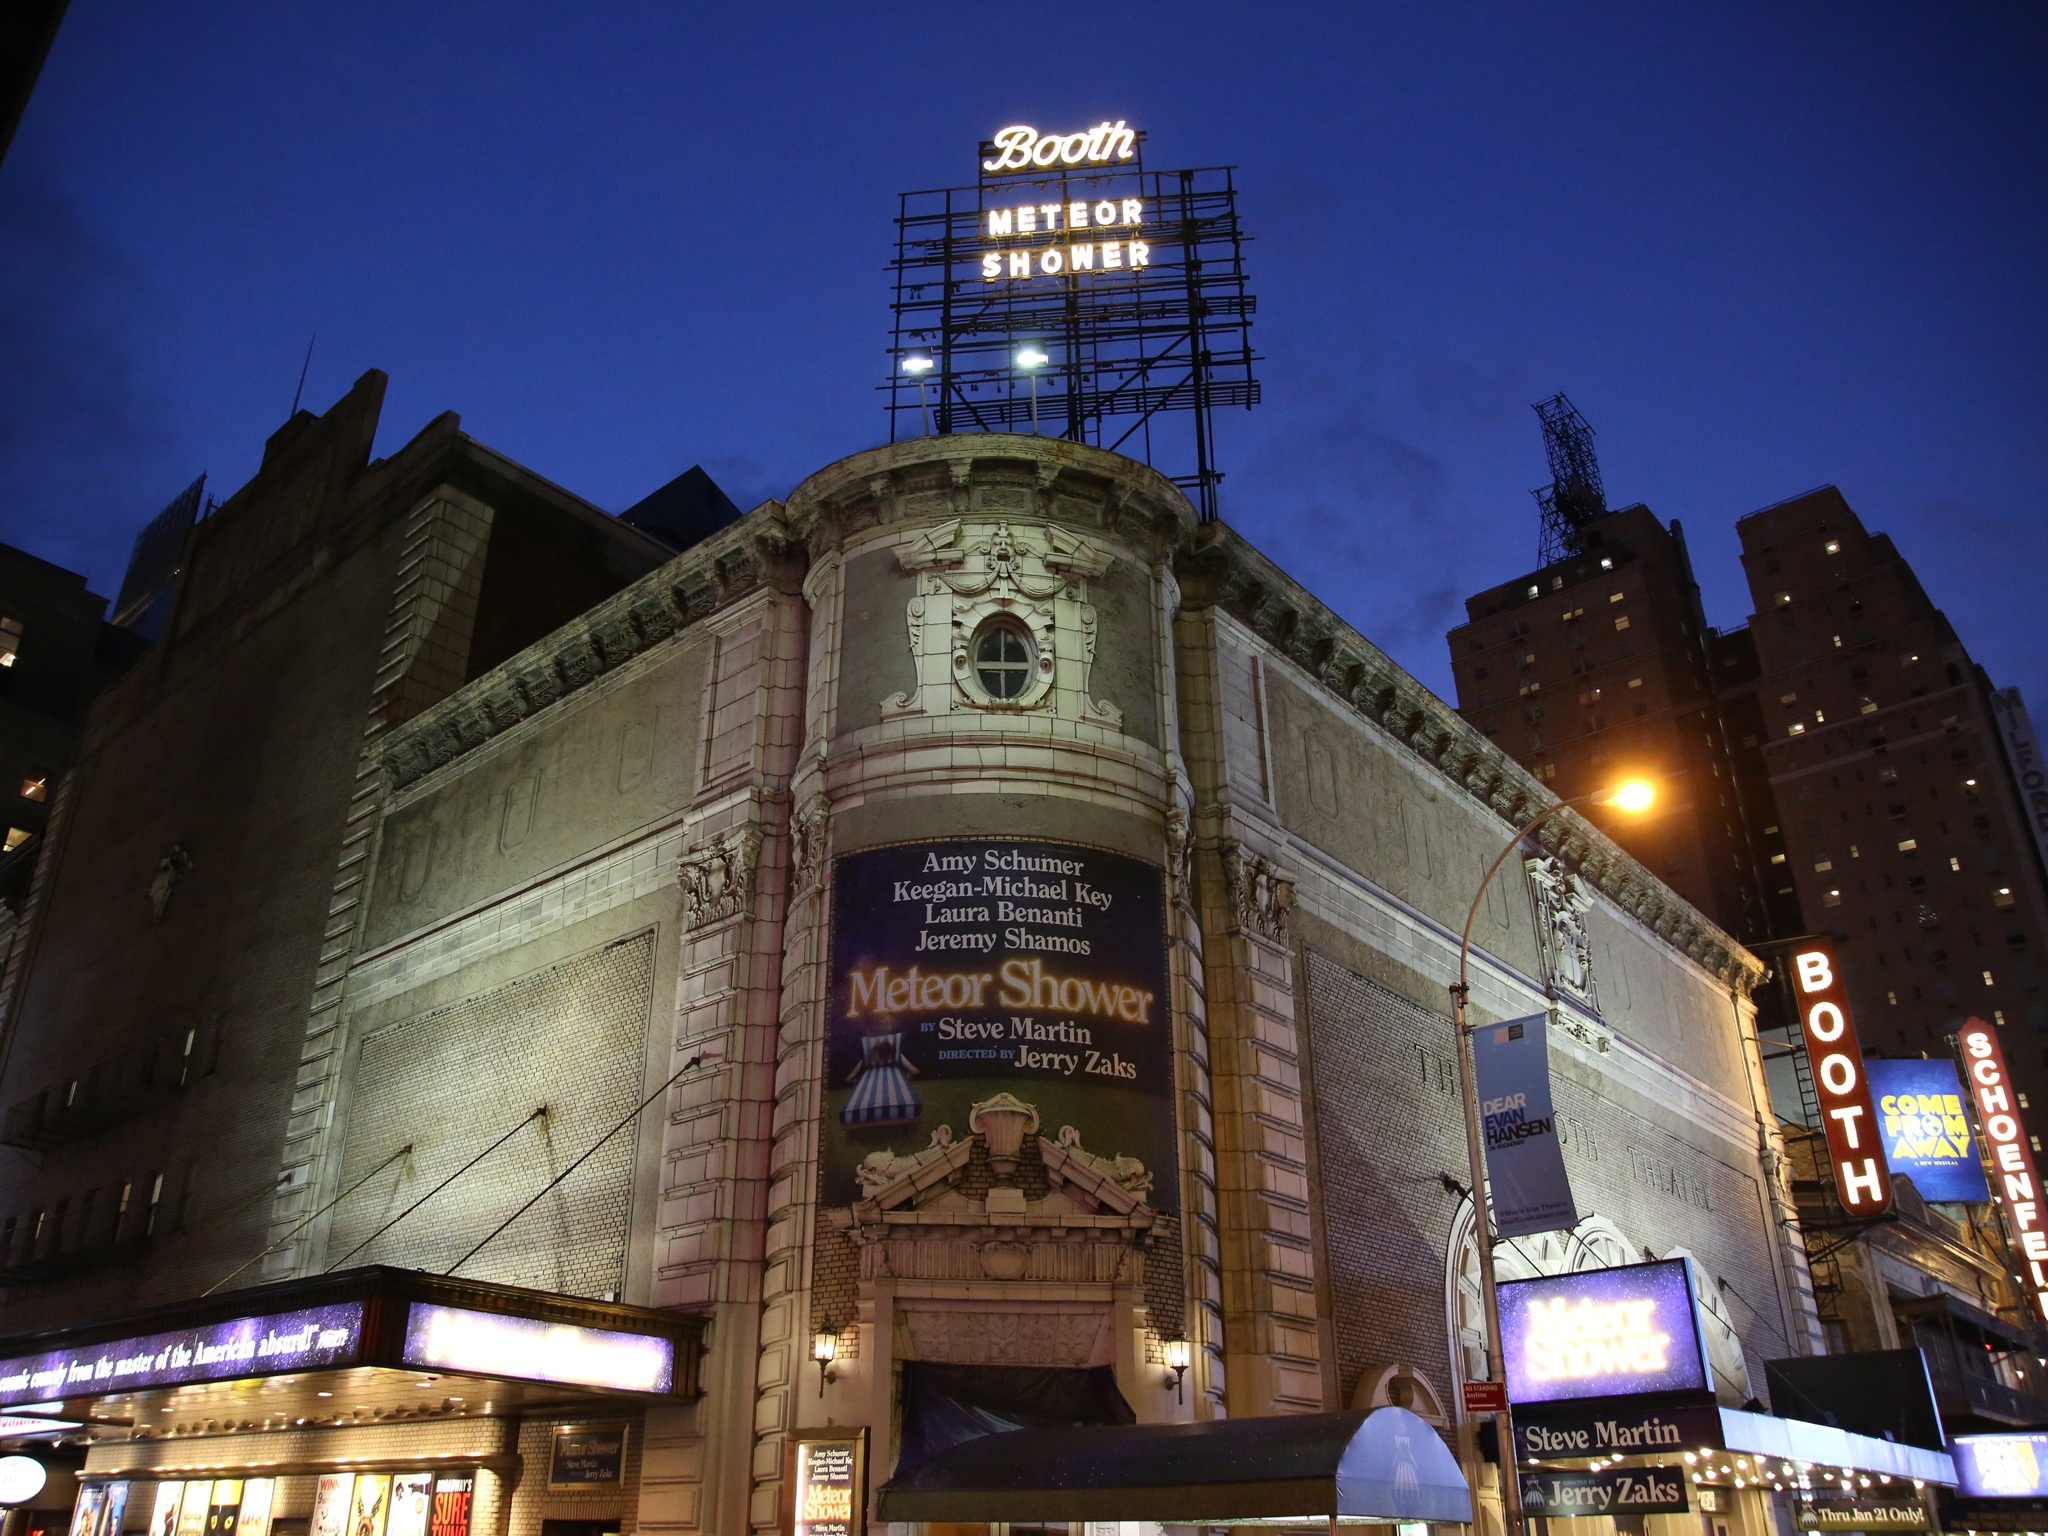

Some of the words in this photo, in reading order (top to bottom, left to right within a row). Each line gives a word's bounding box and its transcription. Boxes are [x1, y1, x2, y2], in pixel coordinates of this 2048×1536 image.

[984, 120, 1135, 171] Booth
[989, 199, 1143, 235] METEOR
[982, 242, 1149, 278] SHOWER
[923, 852, 976, 875] Amy
[984, 850, 1084, 877] Schumer
[893, 877, 1068, 902] Keegan-Michael
[1075, 883, 1112, 910] Key
[925, 903, 990, 924] Laura
[997, 902, 1083, 928] Benanti
[915, 930, 997, 953] Jeremy
[1004, 928, 1091, 955] Shamos
[847, 966, 992, 1018] Meteor
[1000, 959, 1154, 1024] Shower
[920, 1022, 936, 1033] BY
[938, 1017, 1004, 1040] Steve
[1009, 1017, 1092, 1045] Martin
[938, 1049, 996, 1060] DIRECTED
[1000, 1049, 1016, 1060] BY
[1014, 1045, 1078, 1076] Jerry
[1084, 1050, 1137, 1080] Zaks
[1796, 952, 1883, 1204] BOOTH
[1483, 1093, 1527, 1117] DEAR
[1484, 1107, 1525, 1131] EVAN
[1880, 1095, 1963, 1116] COME
[1486, 1117, 1552, 1146] HANSEN
[1884, 1115, 1969, 1137] FROM
[1892, 1136, 1970, 1158] AWAY
[1528, 1296, 1656, 1339] Meteor
[30, 1361, 68, 1389] comedy
[67, 1359, 94, 1384] from
[94, 1354, 115, 1379] the
[114, 1351, 155, 1376] master
[155, 1344, 173, 1370] of
[171, 1342, 192, 1369] the
[193, 1336, 256, 1366] American
[1525, 1333, 1671, 1380] Shower
[1525, 1426, 1590, 1452] Steve
[1593, 1418, 1682, 1449] Martin
[814, 1450, 827, 1459] Amy
[827, 1449, 850, 1458] Schumer
[811, 1473, 829, 1482] Jeremy
[829, 1472, 849, 1480] Shamos
[814, 1465, 828, 1473] Laura
[808, 1485, 852, 1503] Meteor
[1549, 1480, 1612, 1511] Jerry
[1616, 1475, 1680, 1505] Zaks
[432, 1492, 472, 1525] SURE
[1818, 1508, 1851, 1522] Thru
[1852, 1507, 1874, 1522] Jan
[1873, 1507, 1889, 1522] 21
[1889, 1507, 1925, 1526] Only!
